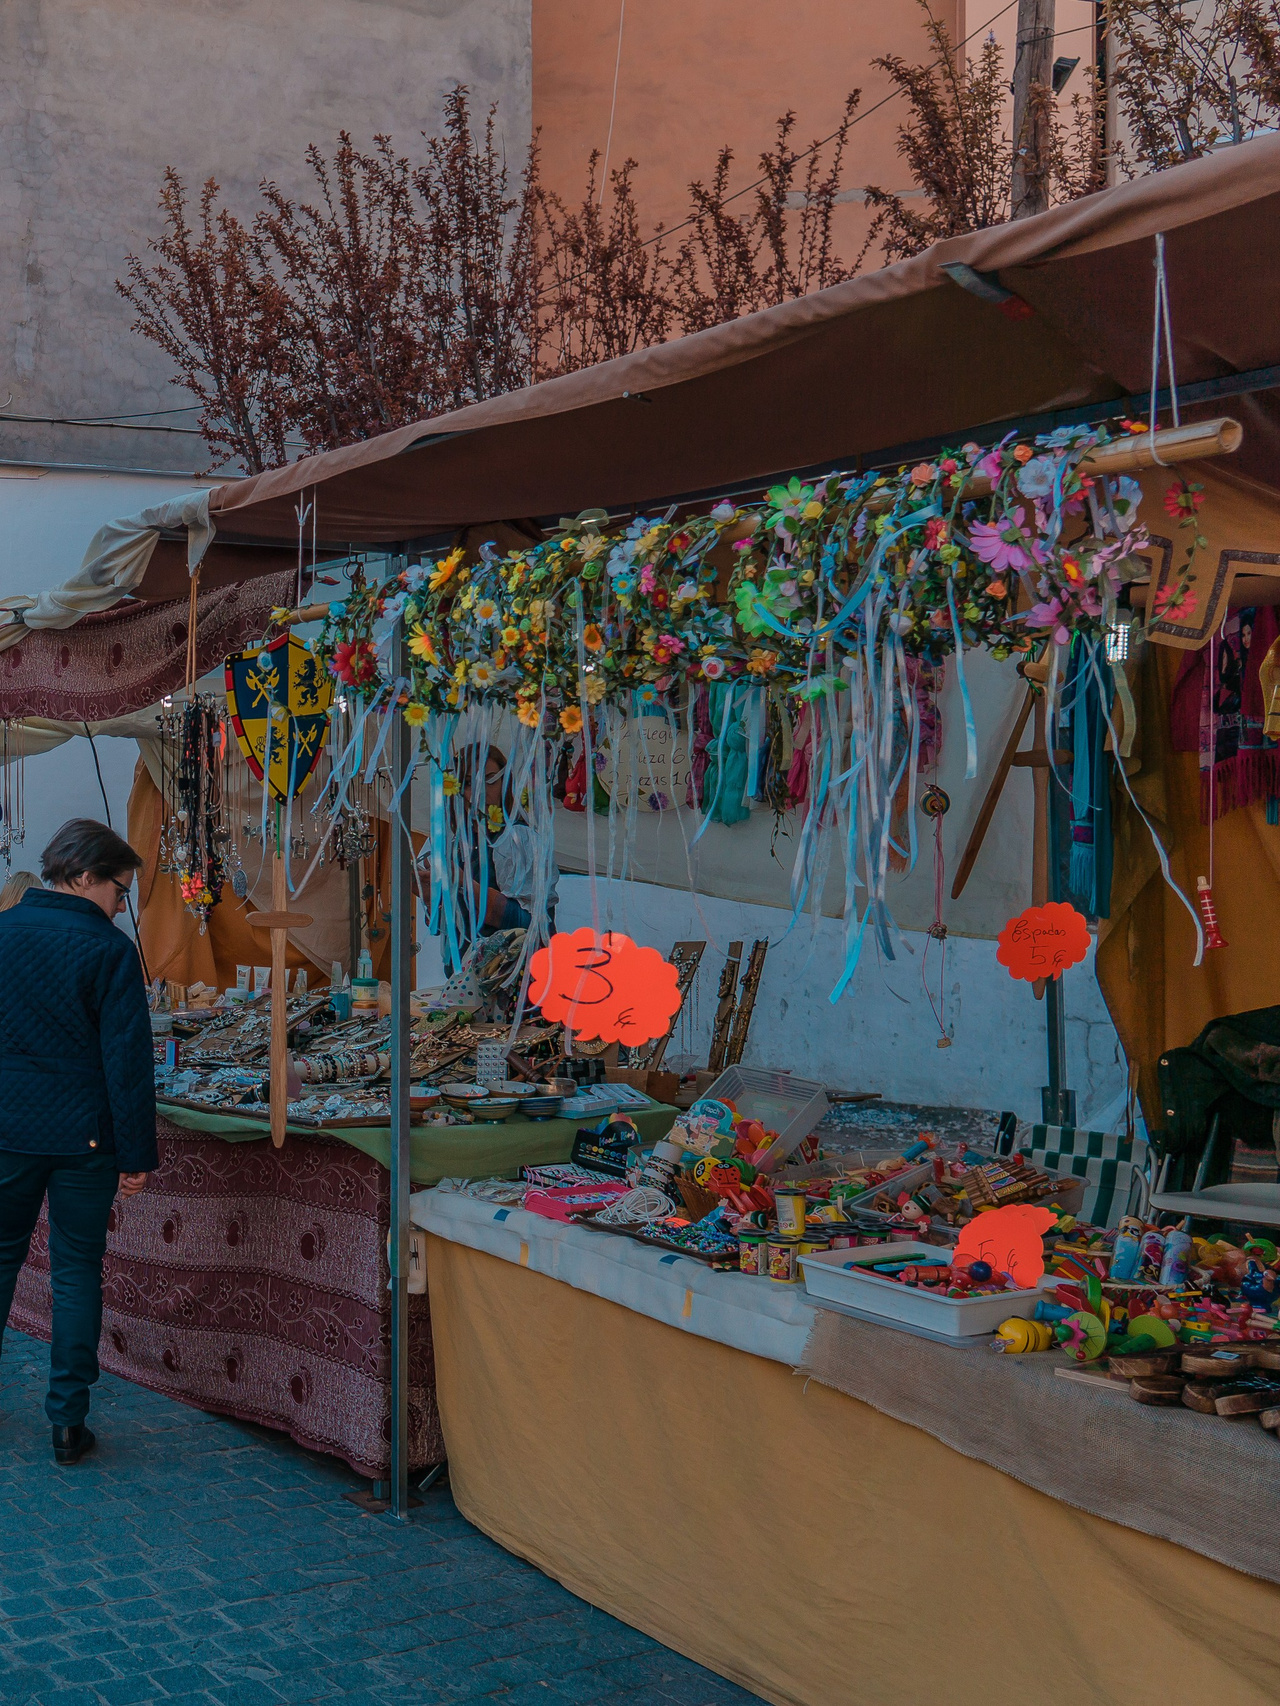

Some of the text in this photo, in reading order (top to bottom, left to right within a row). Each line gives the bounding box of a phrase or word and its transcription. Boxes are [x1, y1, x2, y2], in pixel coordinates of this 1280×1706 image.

[634, 752, 666, 765] ieza
[672, 748, 686, 765] 6
[625, 774, 668, 786] pezas
[1011, 920, 1067, 943] Espadas
[1028, 945, 1050, 965] 5
[558, 947, 613, 1005] 3
